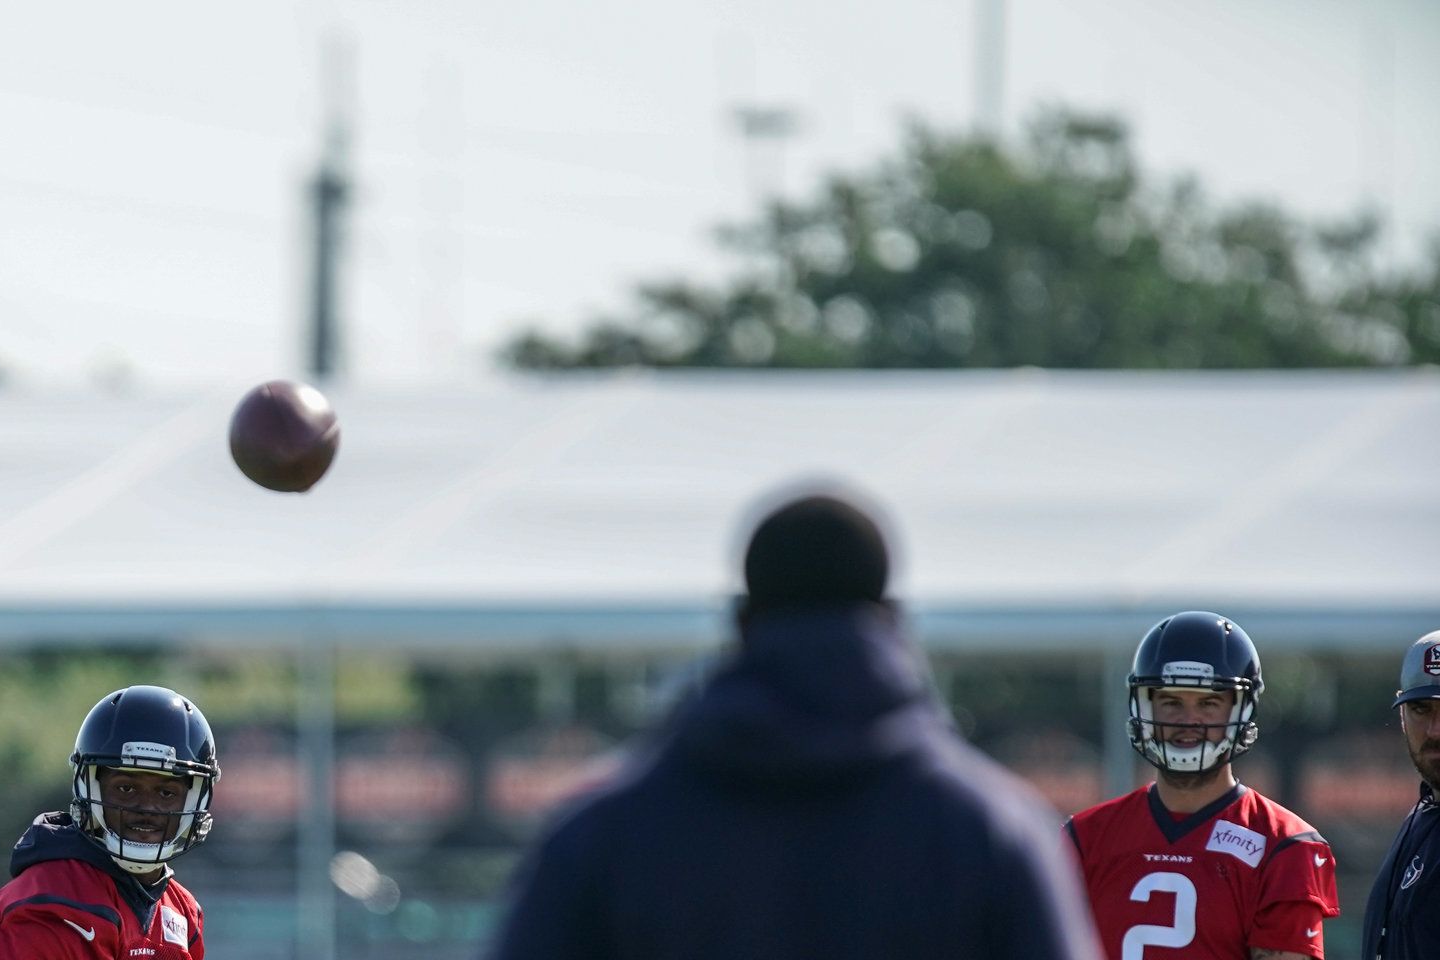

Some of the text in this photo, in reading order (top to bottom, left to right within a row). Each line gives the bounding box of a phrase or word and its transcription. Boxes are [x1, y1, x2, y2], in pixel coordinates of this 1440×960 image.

[1213, 829, 1263, 856] xfinity
[1143, 854, 1193, 863] TEXANS
[129, 948, 155, 957] TEXANS
